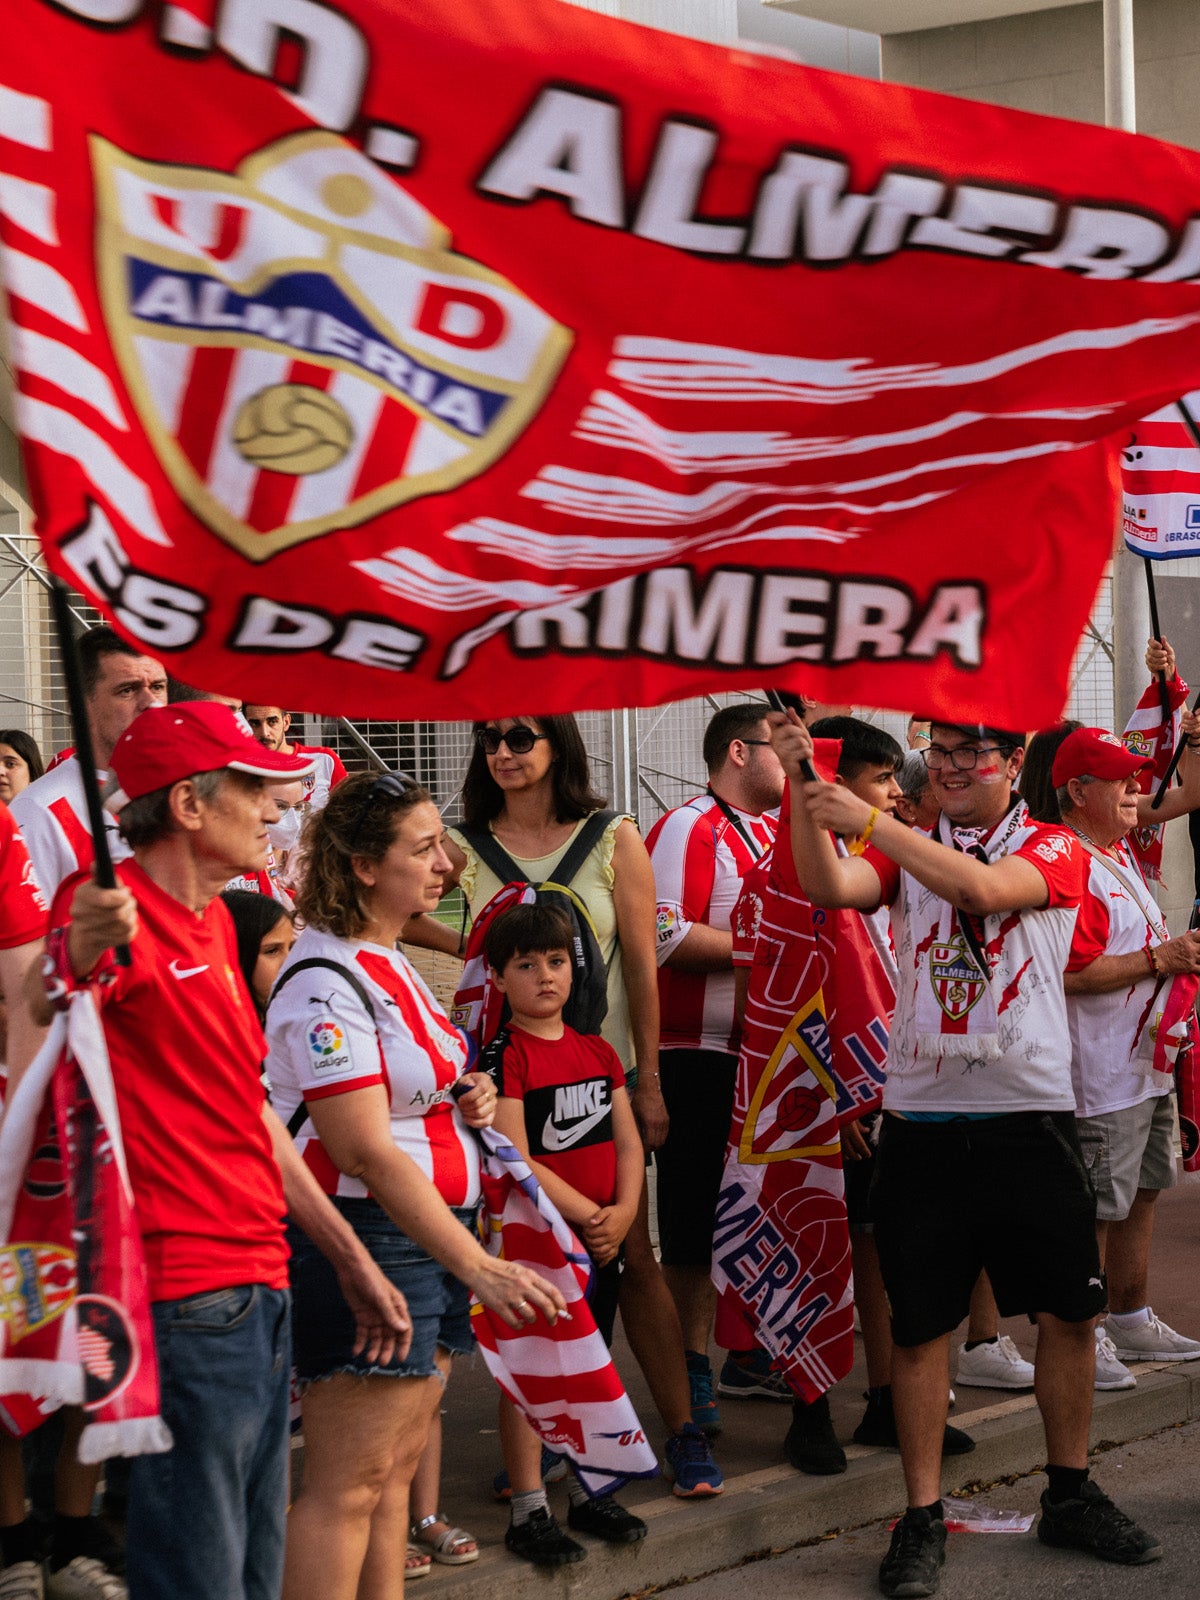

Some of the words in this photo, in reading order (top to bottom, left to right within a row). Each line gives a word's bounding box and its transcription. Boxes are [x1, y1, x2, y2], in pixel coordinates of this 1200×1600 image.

[148, 194, 250, 263] U
[410, 280, 512, 351] D
[133, 272, 492, 438] ALMERIA
[228, 592, 428, 674] DE
[438, 562, 988, 682] RIMERA
[658, 928, 674, 942] LFP
[935, 948, 949, 961] U
[314, 1056, 349, 1070] LaLiga
[554, 1080, 607, 1123] NIKE
